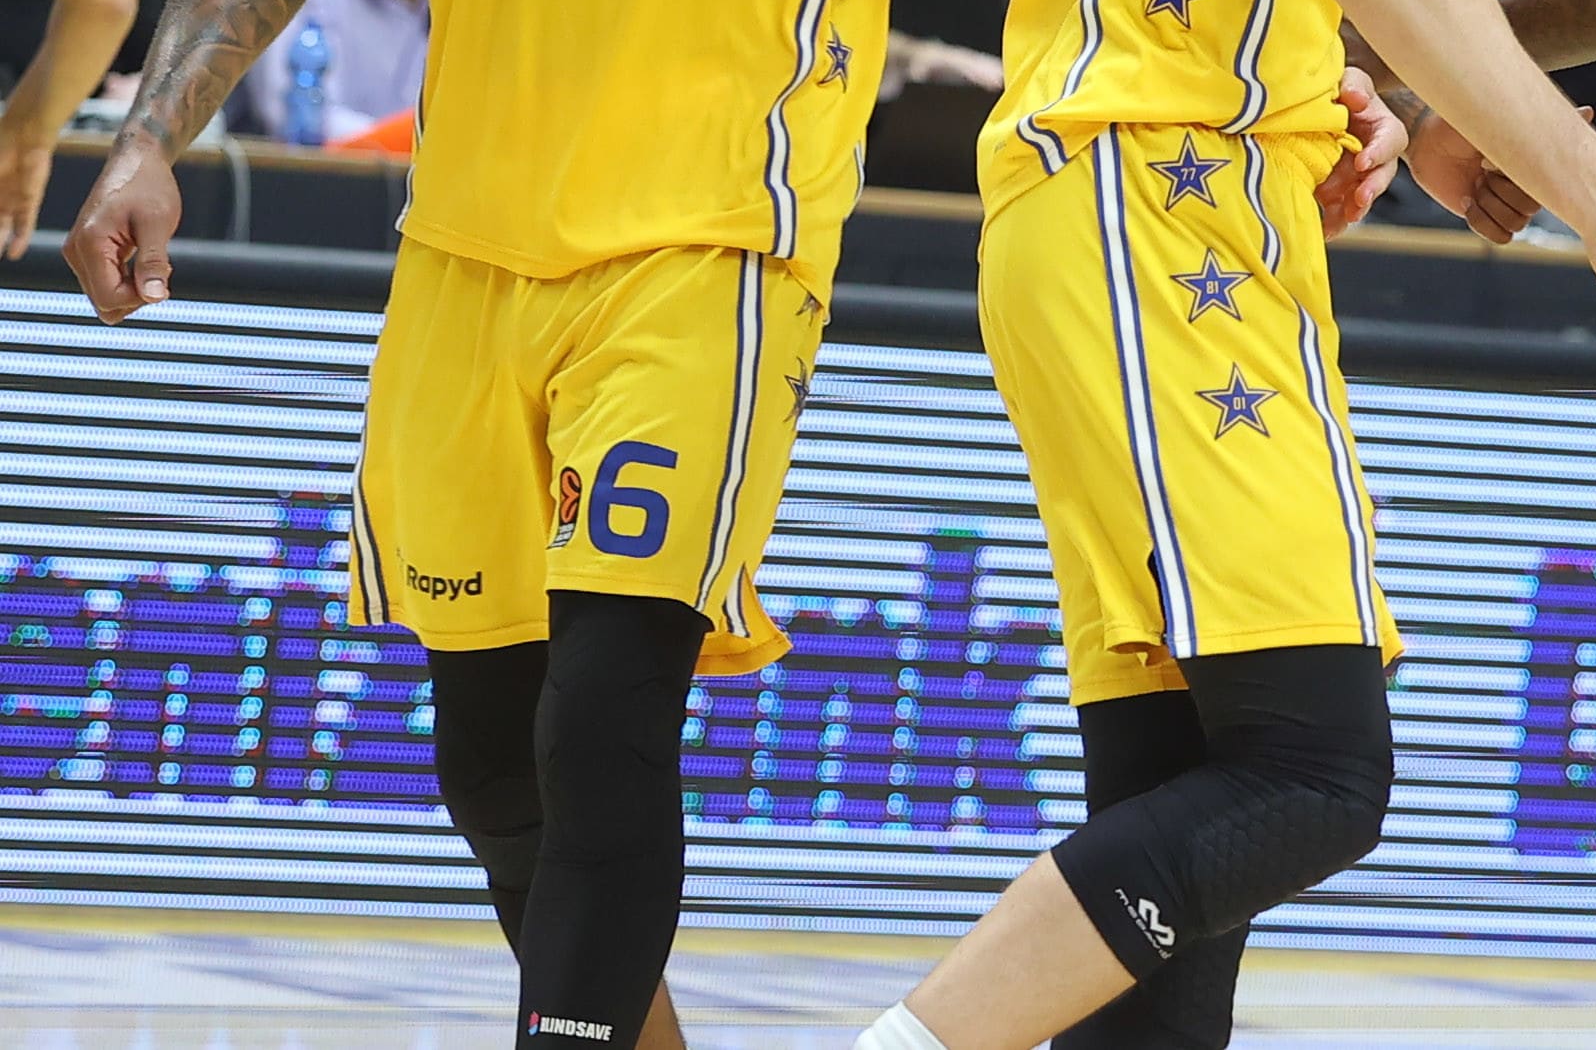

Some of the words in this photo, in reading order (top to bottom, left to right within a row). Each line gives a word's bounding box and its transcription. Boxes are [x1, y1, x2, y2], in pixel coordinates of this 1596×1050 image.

[1179, 166, 1198, 182] 77
[1205, 280, 1220, 294] 81
[588, 440, 679, 559] 6
[405, 563, 484, 601] Rapyd
[539, 1016, 614, 1042] BLINDSAVE
